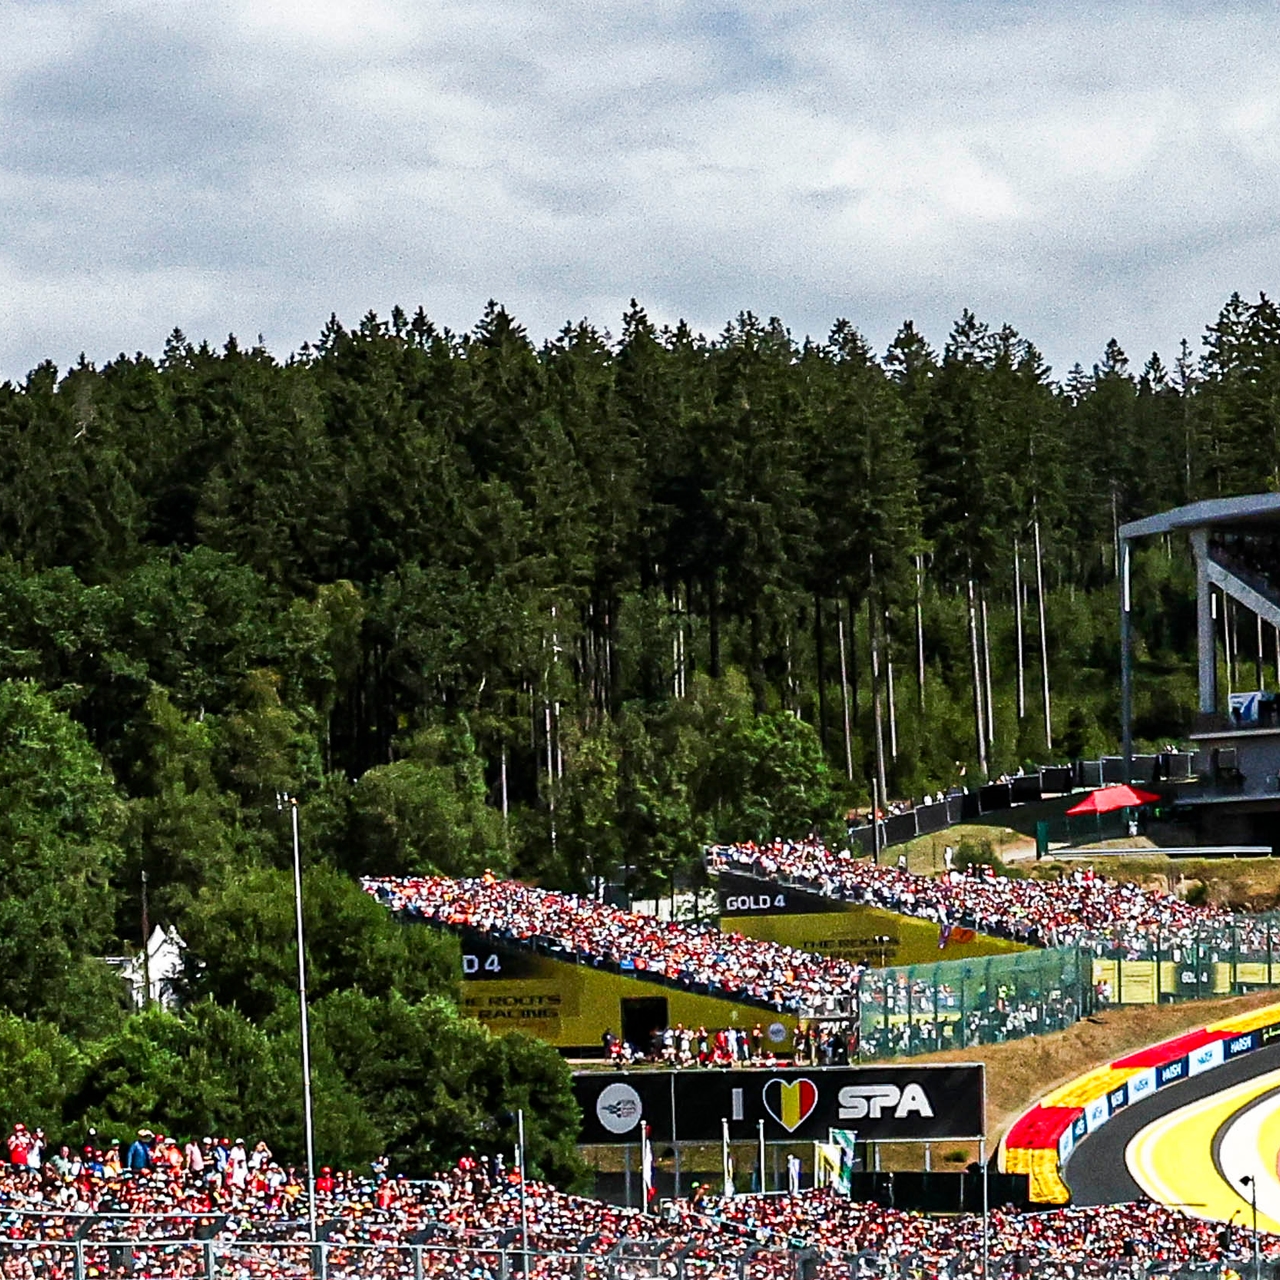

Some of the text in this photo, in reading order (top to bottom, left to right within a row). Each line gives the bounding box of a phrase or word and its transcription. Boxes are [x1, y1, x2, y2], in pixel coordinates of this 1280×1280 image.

[726, 894, 786, 910] GOLD 4
[484, 954, 501, 973] 4
[732, 1083, 934, 1121] I SPA
